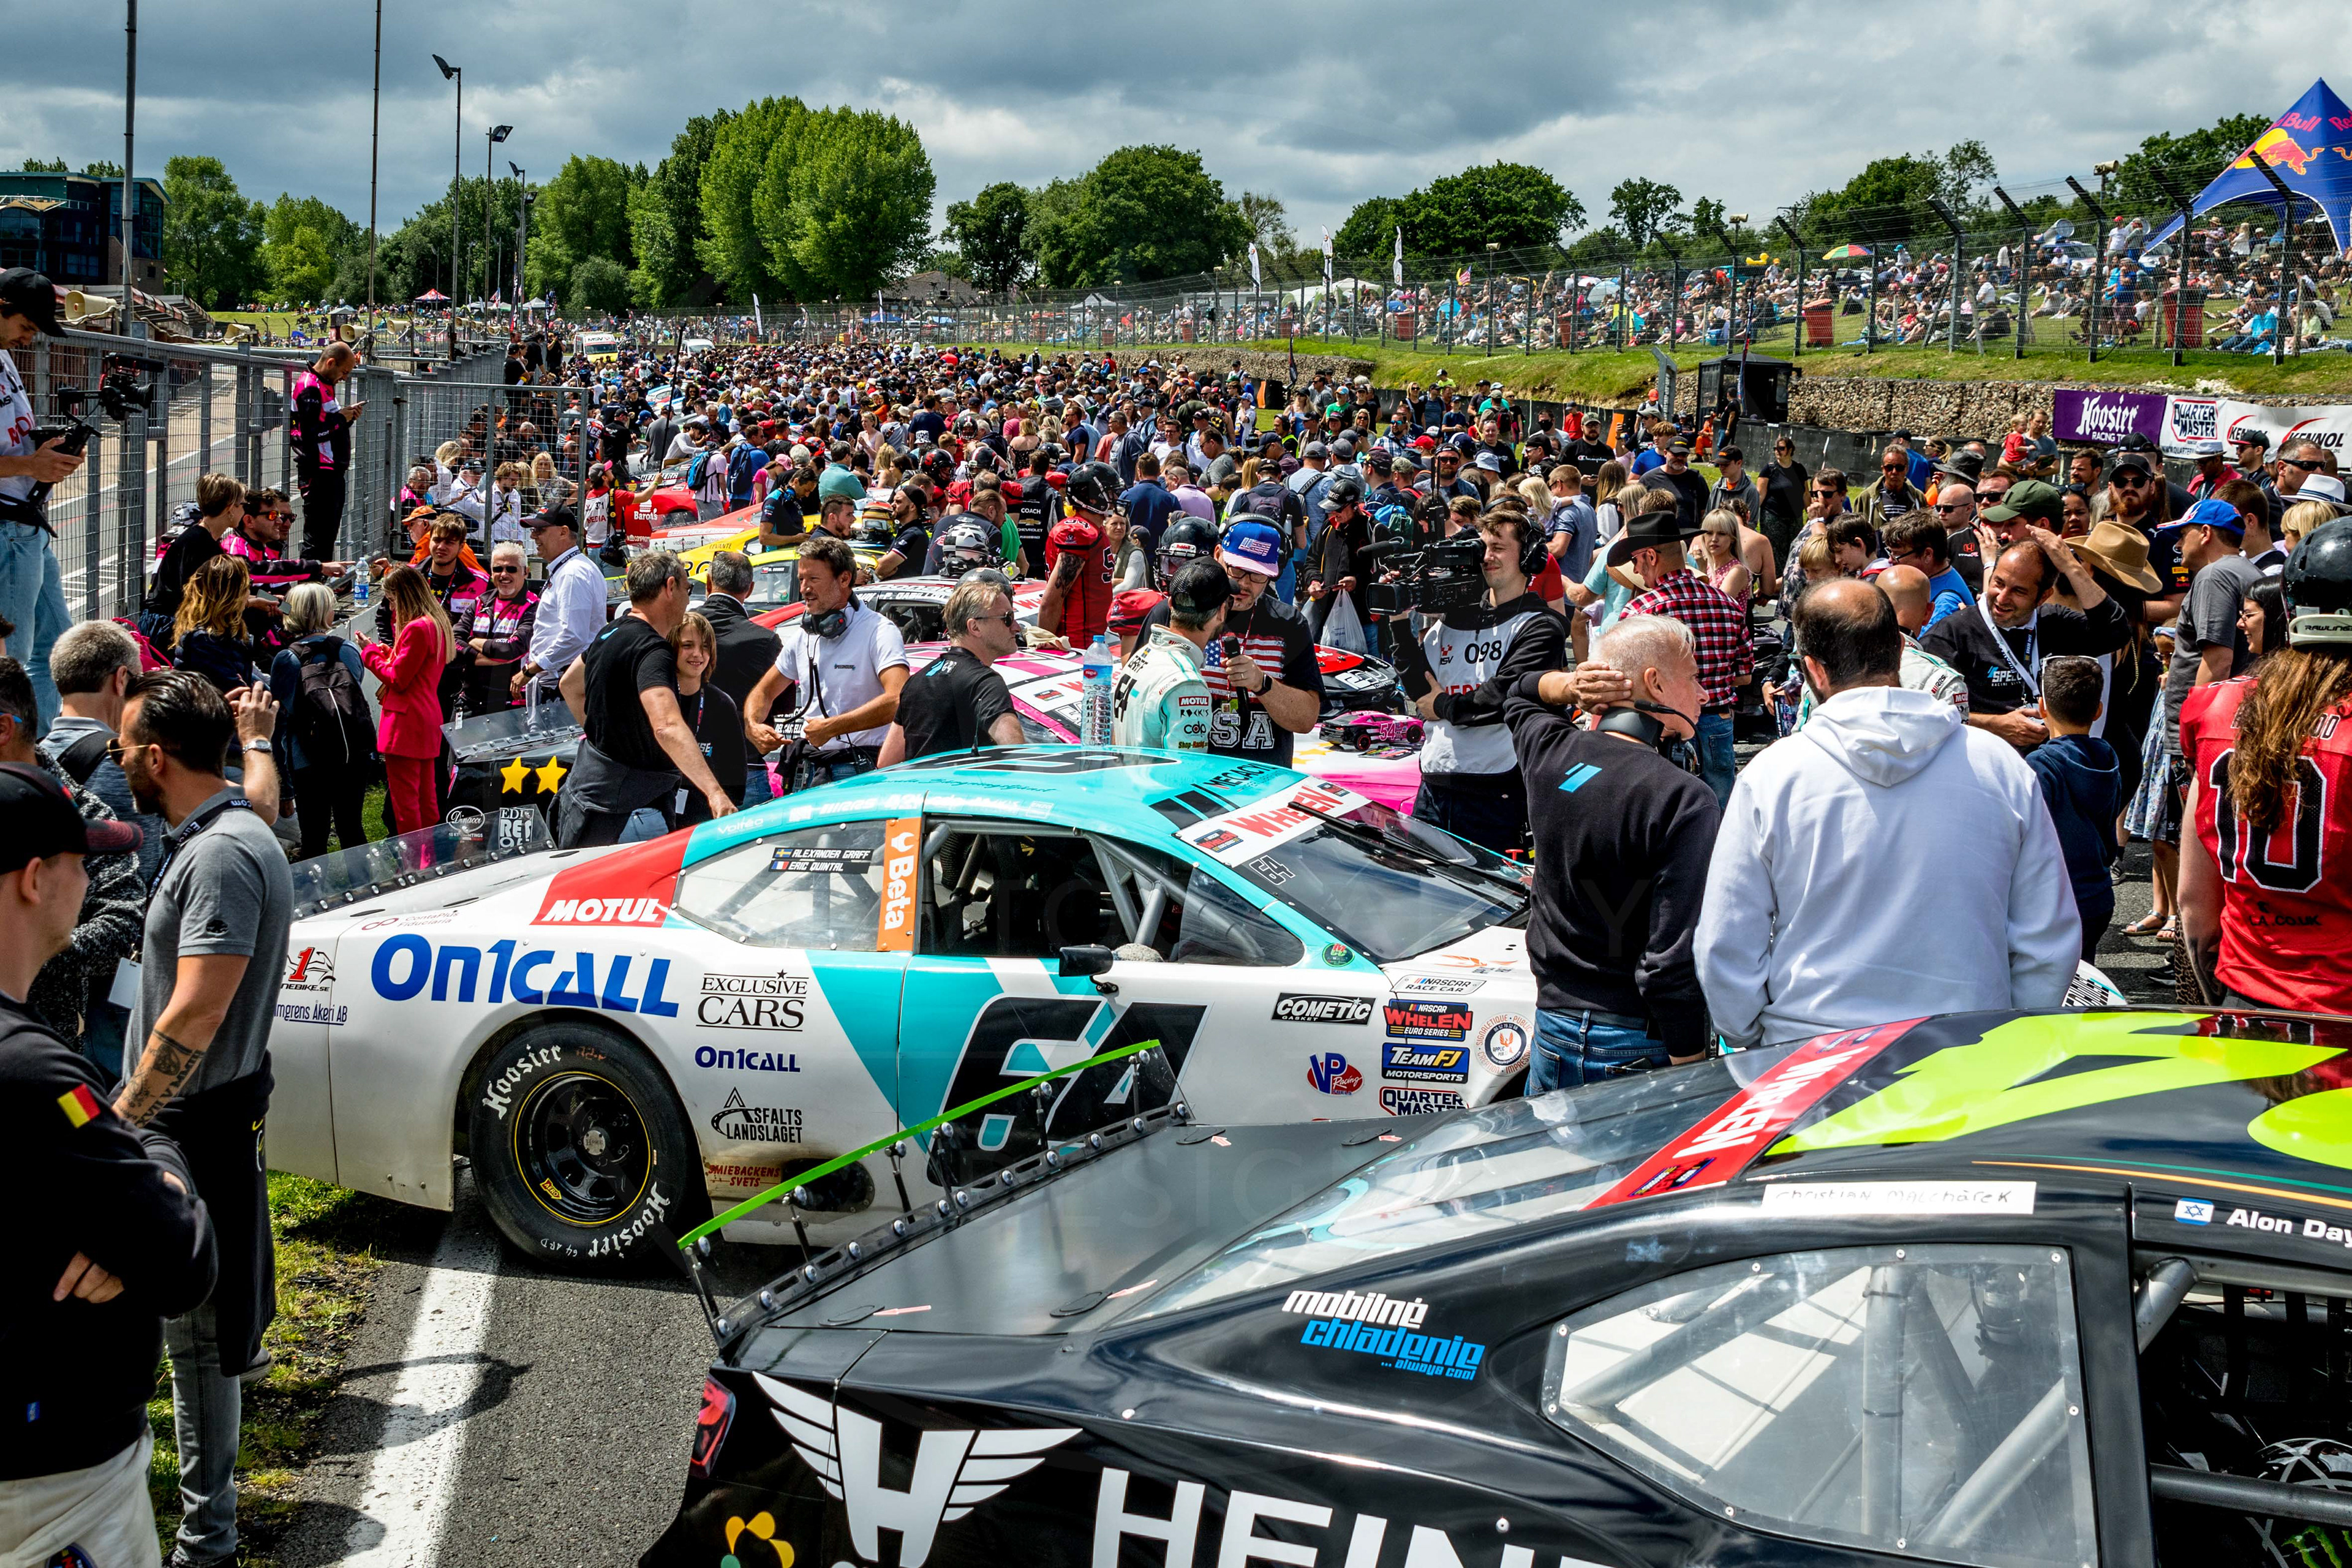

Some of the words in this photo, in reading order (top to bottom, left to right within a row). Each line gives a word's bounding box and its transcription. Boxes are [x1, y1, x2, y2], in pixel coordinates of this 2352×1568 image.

[2282, 112, 2322, 132] Bull
[2075, 394, 2138, 435] Hoosier
[2174, 404, 2216, 426] QUARTER
[2092, 431, 2116, 442] RACING
[2179, 420, 2216, 437] MASTER
[595, 501, 605, 510] 371
[634, 508, 658, 521] Barot's
[587, 514, 606, 524] MEDIA
[1464, 639, 1502, 664] 098
[1181, 697, 1208, 706] MOTUL
[1209, 707, 1275, 750] SA
[1380, 723, 1396, 742] 54
[1222, 785, 1344, 838] WHEEN
[792, 848, 842, 860] ALEXANDER
[842, 850, 870, 860] GRAFF
[788, 861, 807, 870] ERIC
[809, 862, 844, 872] QUINTAL
[1249, 855, 1295, 886] 64
[884, 854, 914, 930] Beta
[541, 898, 661, 922] MOTUL
[280, 982, 330, 993] NEBIKE.SE
[701, 977, 808, 995] EXCLUSIVE
[1424, 978, 1472, 988] NASCAR
[336, 1005, 348, 1023] AB
[698, 996, 805, 1028] CARS
[1276, 998, 1371, 1020] COMETIC
[1384, 1006, 1472, 1030] WHELEN
[1418, 1005, 1448, 1014] NASCAR
[482, 1043, 562, 1120] Hoosier
[1310, 1052, 1347, 1095] VP
[1333, 1075, 1363, 1089] Racing
[1385, 1070, 1464, 1082] MOTORSPORTS
[1382, 1089, 1464, 1107] QUARTER
[1673, 1046, 1869, 1160] WHELEN
[726, 1123, 802, 1144] LANDSLAGET
[543, 1182, 559, 1197] AERO
[729, 1177, 761, 1187] SVETS
[587, 1181, 671, 1259] Hoosier
[2226, 1208, 2293, 1234] Alon
[1395, 1359, 1443, 1376] always
[1445, 1367, 1476, 1381] cool
